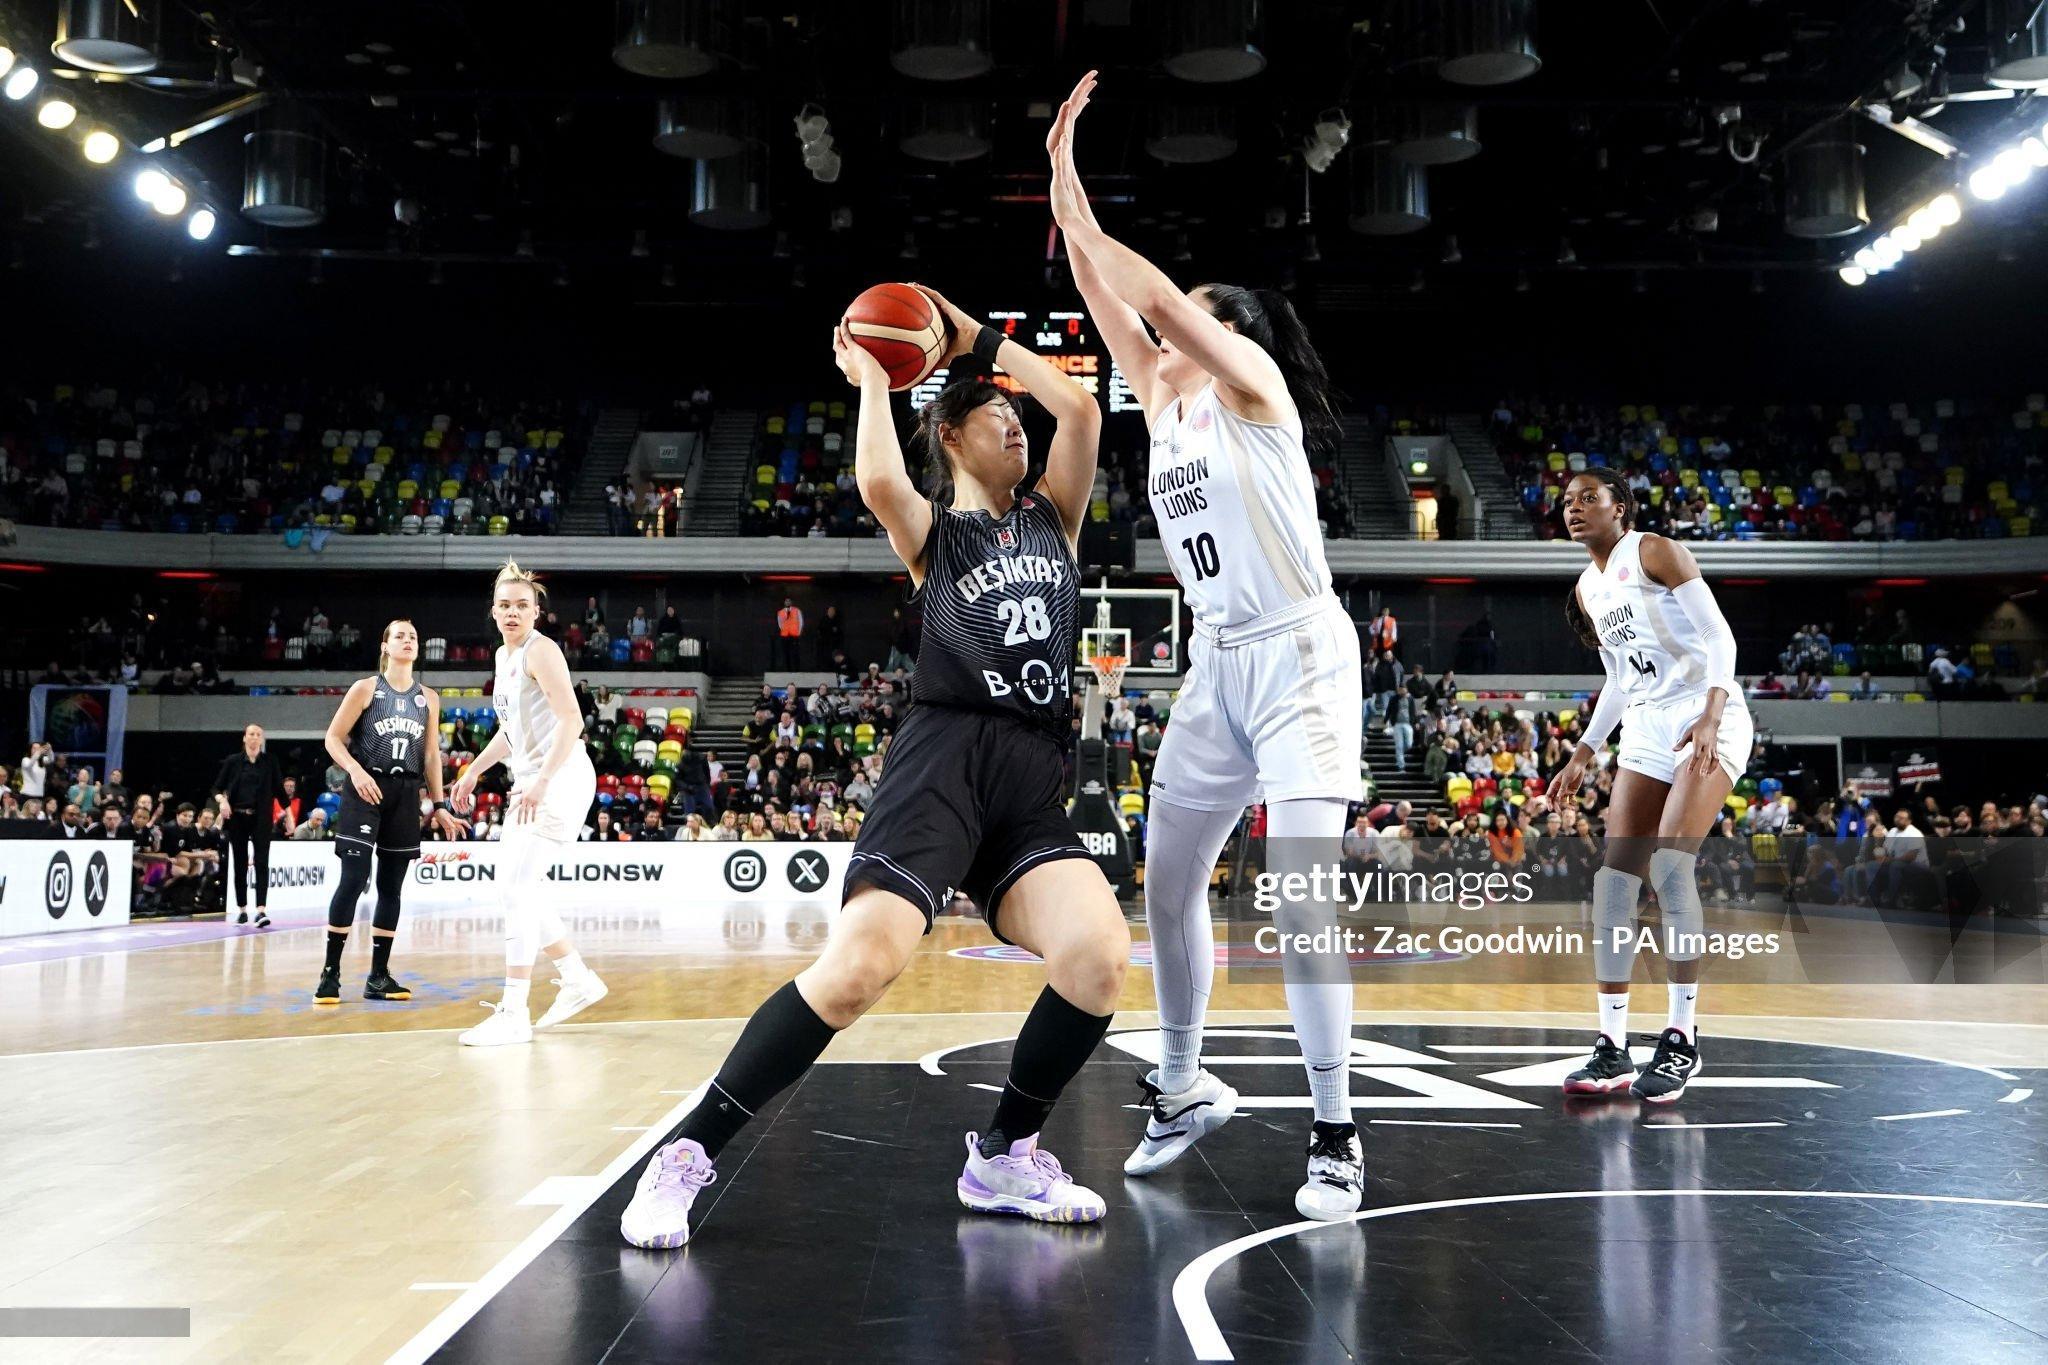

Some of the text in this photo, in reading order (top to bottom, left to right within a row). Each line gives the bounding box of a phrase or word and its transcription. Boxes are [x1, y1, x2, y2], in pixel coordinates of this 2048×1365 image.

[1152, 456, 1209, 496] LONDON
[1162, 487, 1208, 520] LIONS
[1182, 531, 1221, 582] 10
[998, 595, 1052, 647] 28
[1014, 677, 1060, 689] YACHTS
[391, 737, 409, 760] 17
